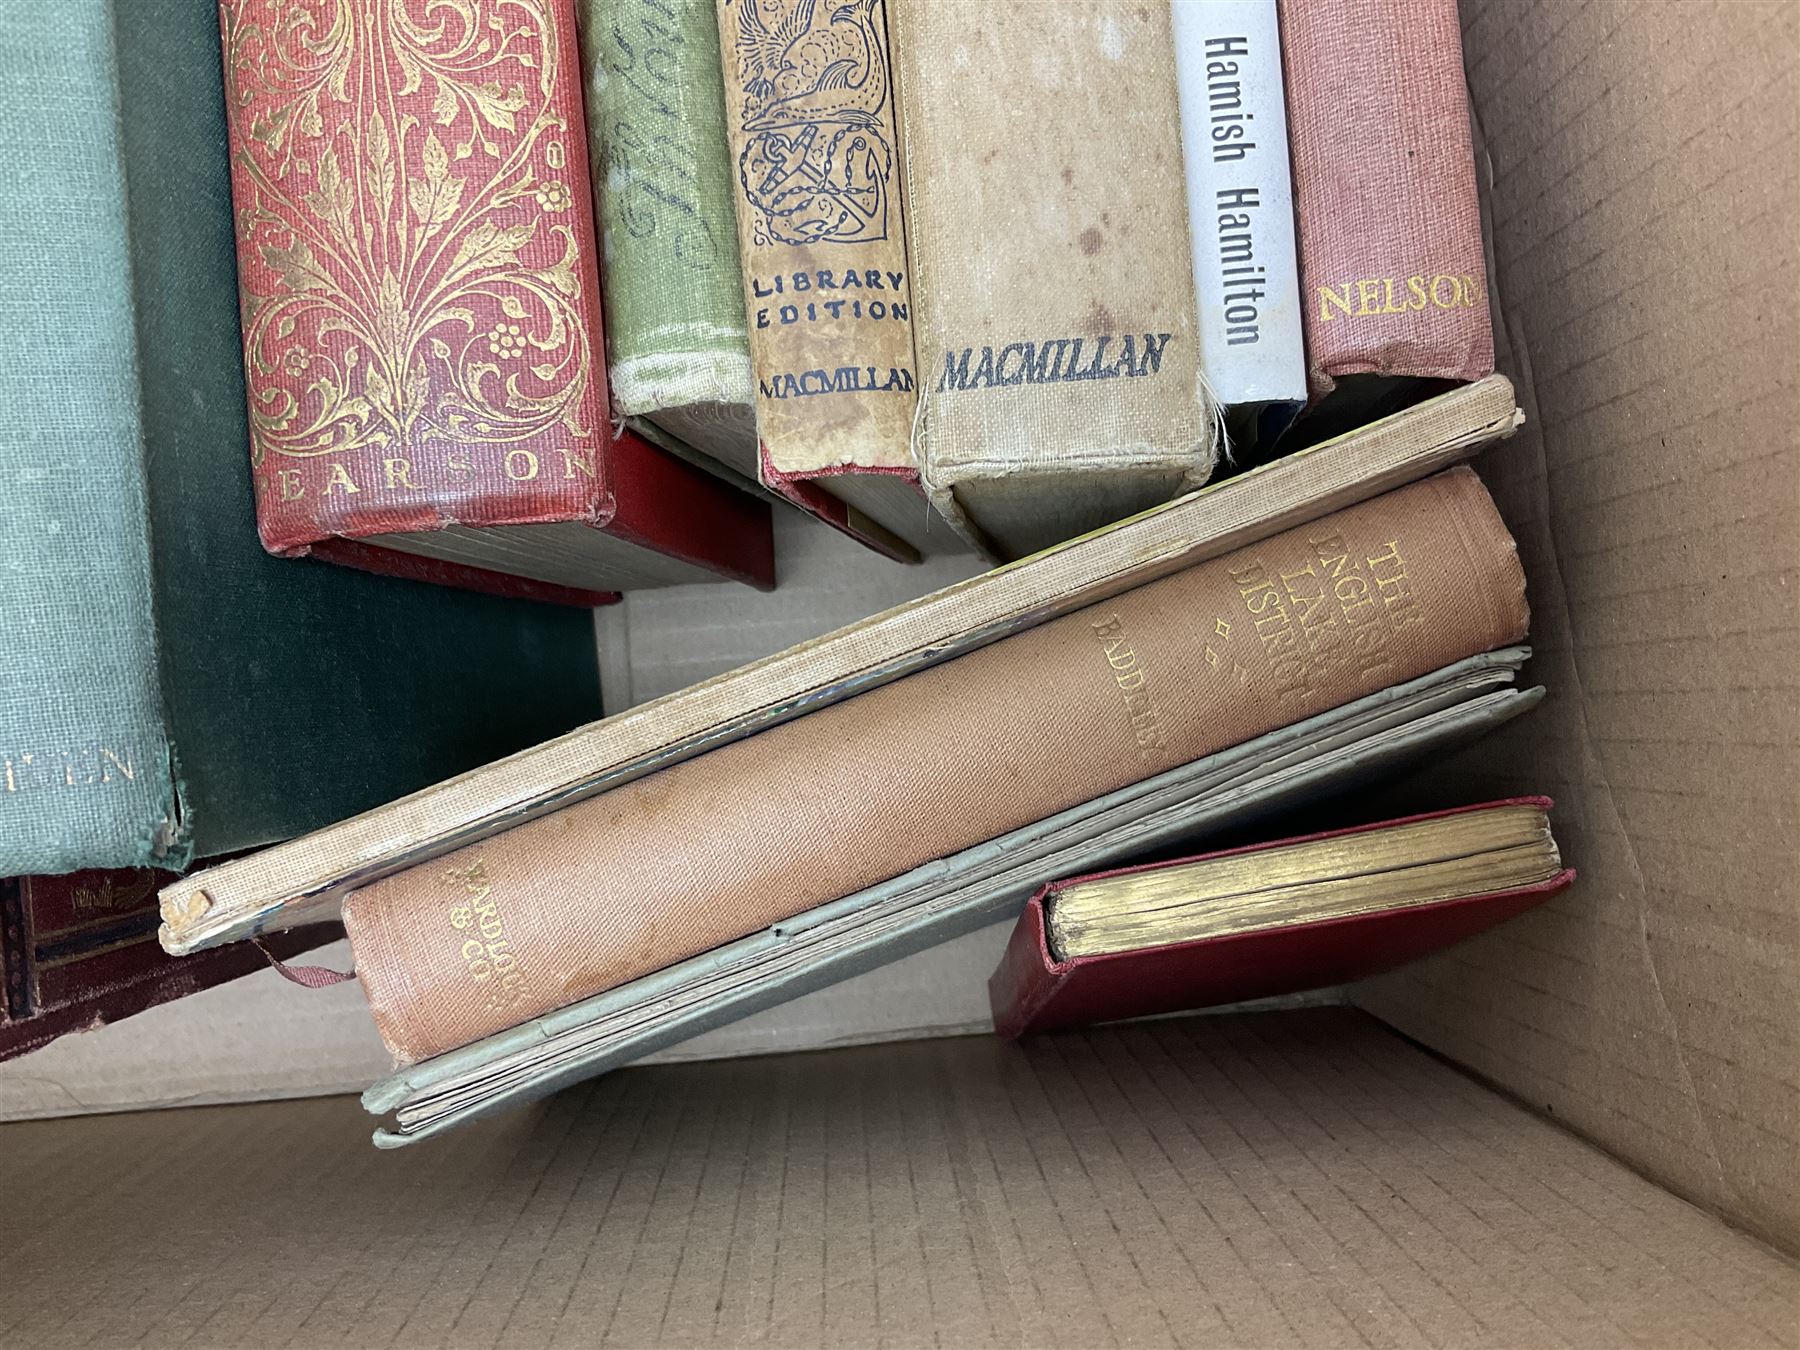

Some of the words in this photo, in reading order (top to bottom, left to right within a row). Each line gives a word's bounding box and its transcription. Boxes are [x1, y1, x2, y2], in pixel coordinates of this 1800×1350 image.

[1205, 36, 1257, 163] Hamish
[752, 269, 904, 298] LIBRARY
[1216, 188, 1266, 346] Hamilton
[756, 300, 909, 329] EDITION
[1317, 275, 1482, 321] NELSON
[760, 366, 914, 399] MACMILLAN
[937, 333, 1171, 392] MACMILLAN
[1309, 530, 1393, 679] ENGLISH
[1367, 540, 1425, 629] THE
[1229, 558, 1315, 702] DISTRICT
[450, 905, 475, 930] &
